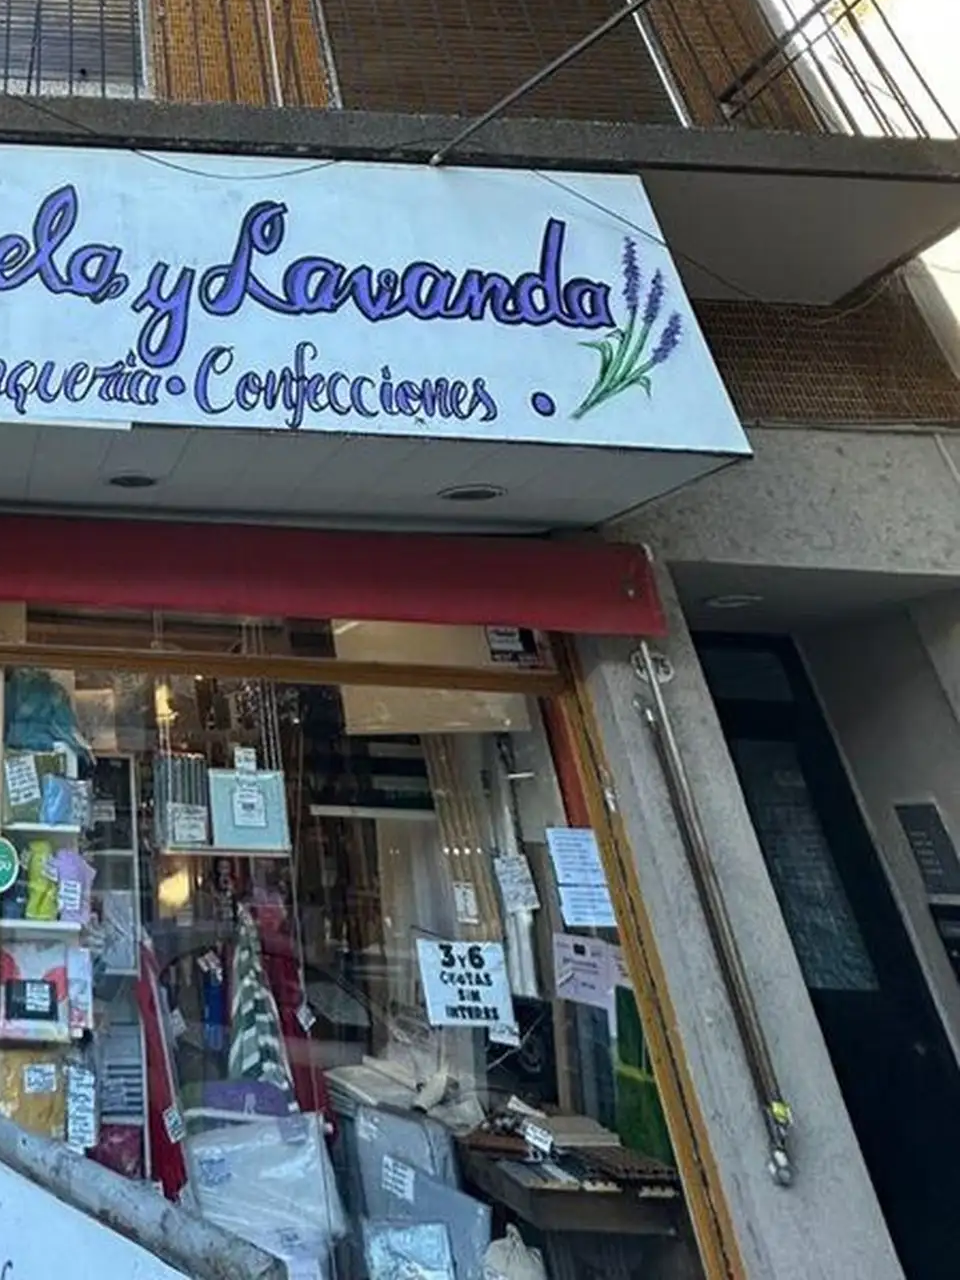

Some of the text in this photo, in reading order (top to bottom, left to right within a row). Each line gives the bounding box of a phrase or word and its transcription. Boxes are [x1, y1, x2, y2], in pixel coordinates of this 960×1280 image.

[131, 261, 193, 367] y
[198, 200, 618, 329] Lavanda
[195, 341, 498, 429] Confecciones
[439, 943, 456, 968] 3
[467, 945, 486, 970] 6
[458, 988, 482, 1003] SIN
